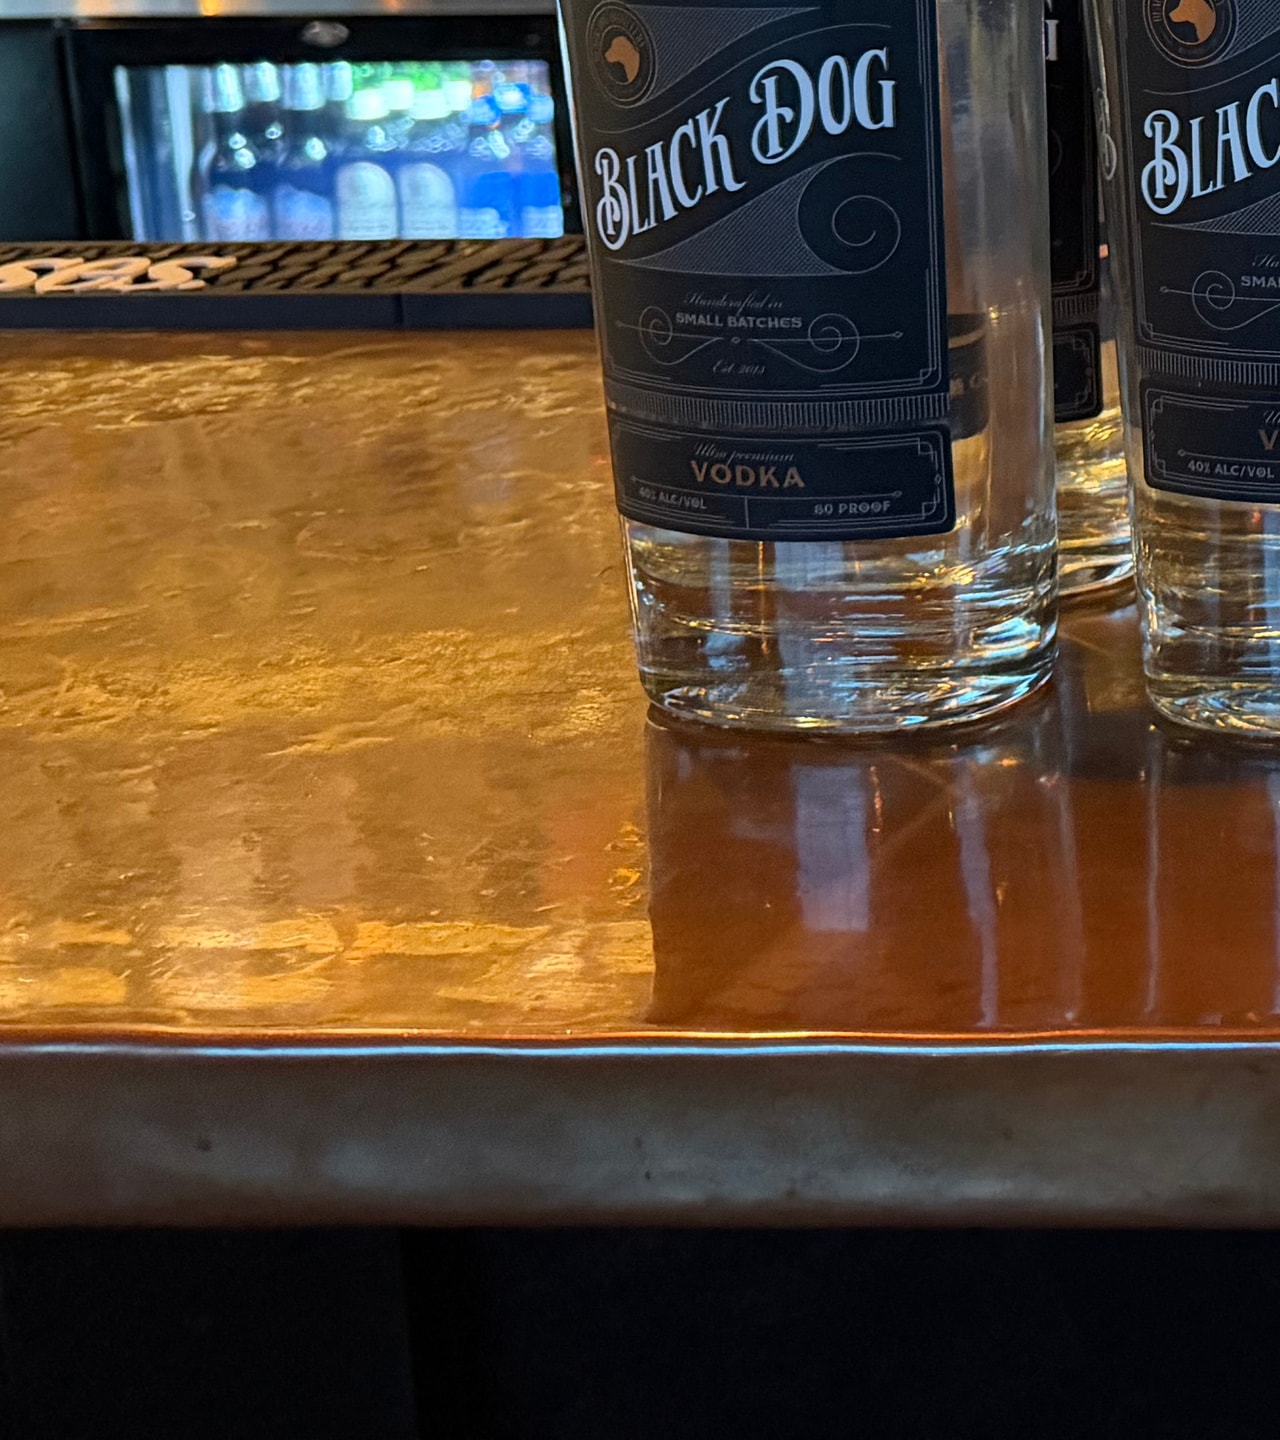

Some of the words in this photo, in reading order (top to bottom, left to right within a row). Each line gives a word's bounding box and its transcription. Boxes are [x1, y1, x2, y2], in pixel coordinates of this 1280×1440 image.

[594, 96, 748, 250] BLACK
[748, 46, 898, 165] DOG
[676, 311, 724, 328] SMALL
[727, 314, 803, 329] BATCHES
[690, 460, 806, 489] VODKA
[1187, 460, 1211, 474] 40%
[1214, 462, 1275, 479] ALC/VOL
[813, 503, 834, 515] 80
[838, 500, 891, 515] PROOF
